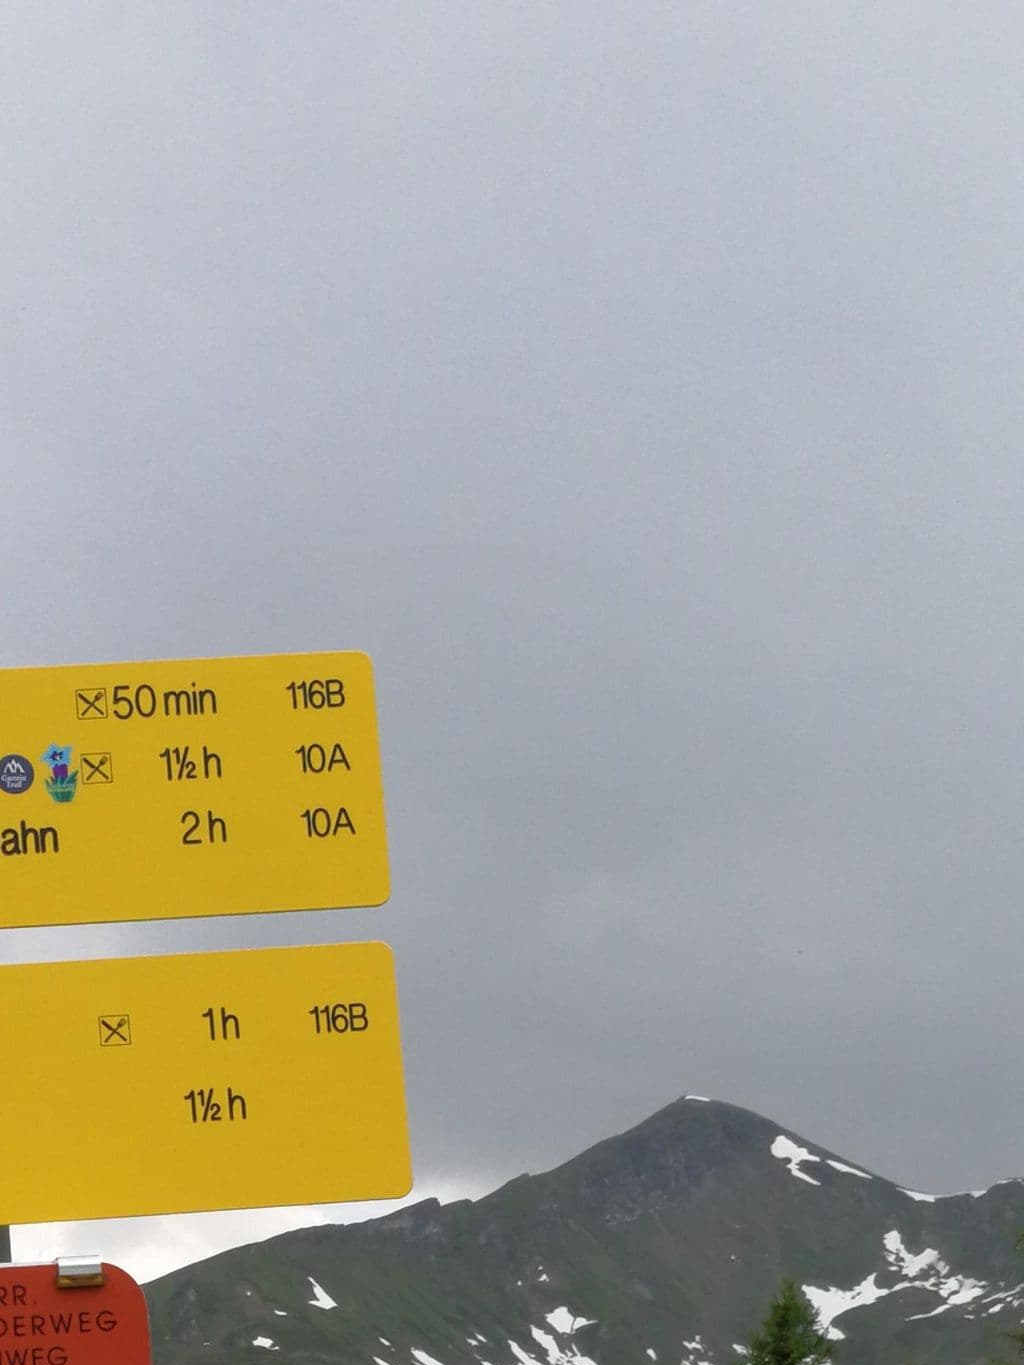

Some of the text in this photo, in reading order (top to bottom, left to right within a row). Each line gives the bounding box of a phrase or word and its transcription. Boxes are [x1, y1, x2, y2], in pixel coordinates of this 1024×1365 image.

[112, 682, 217, 720] 50 min
[285, 678, 346, 710] 116B
[295, 743, 351, 774] 10A
[300, 807, 357, 838] 10A
[308, 1002, 369, 1034] 116B
